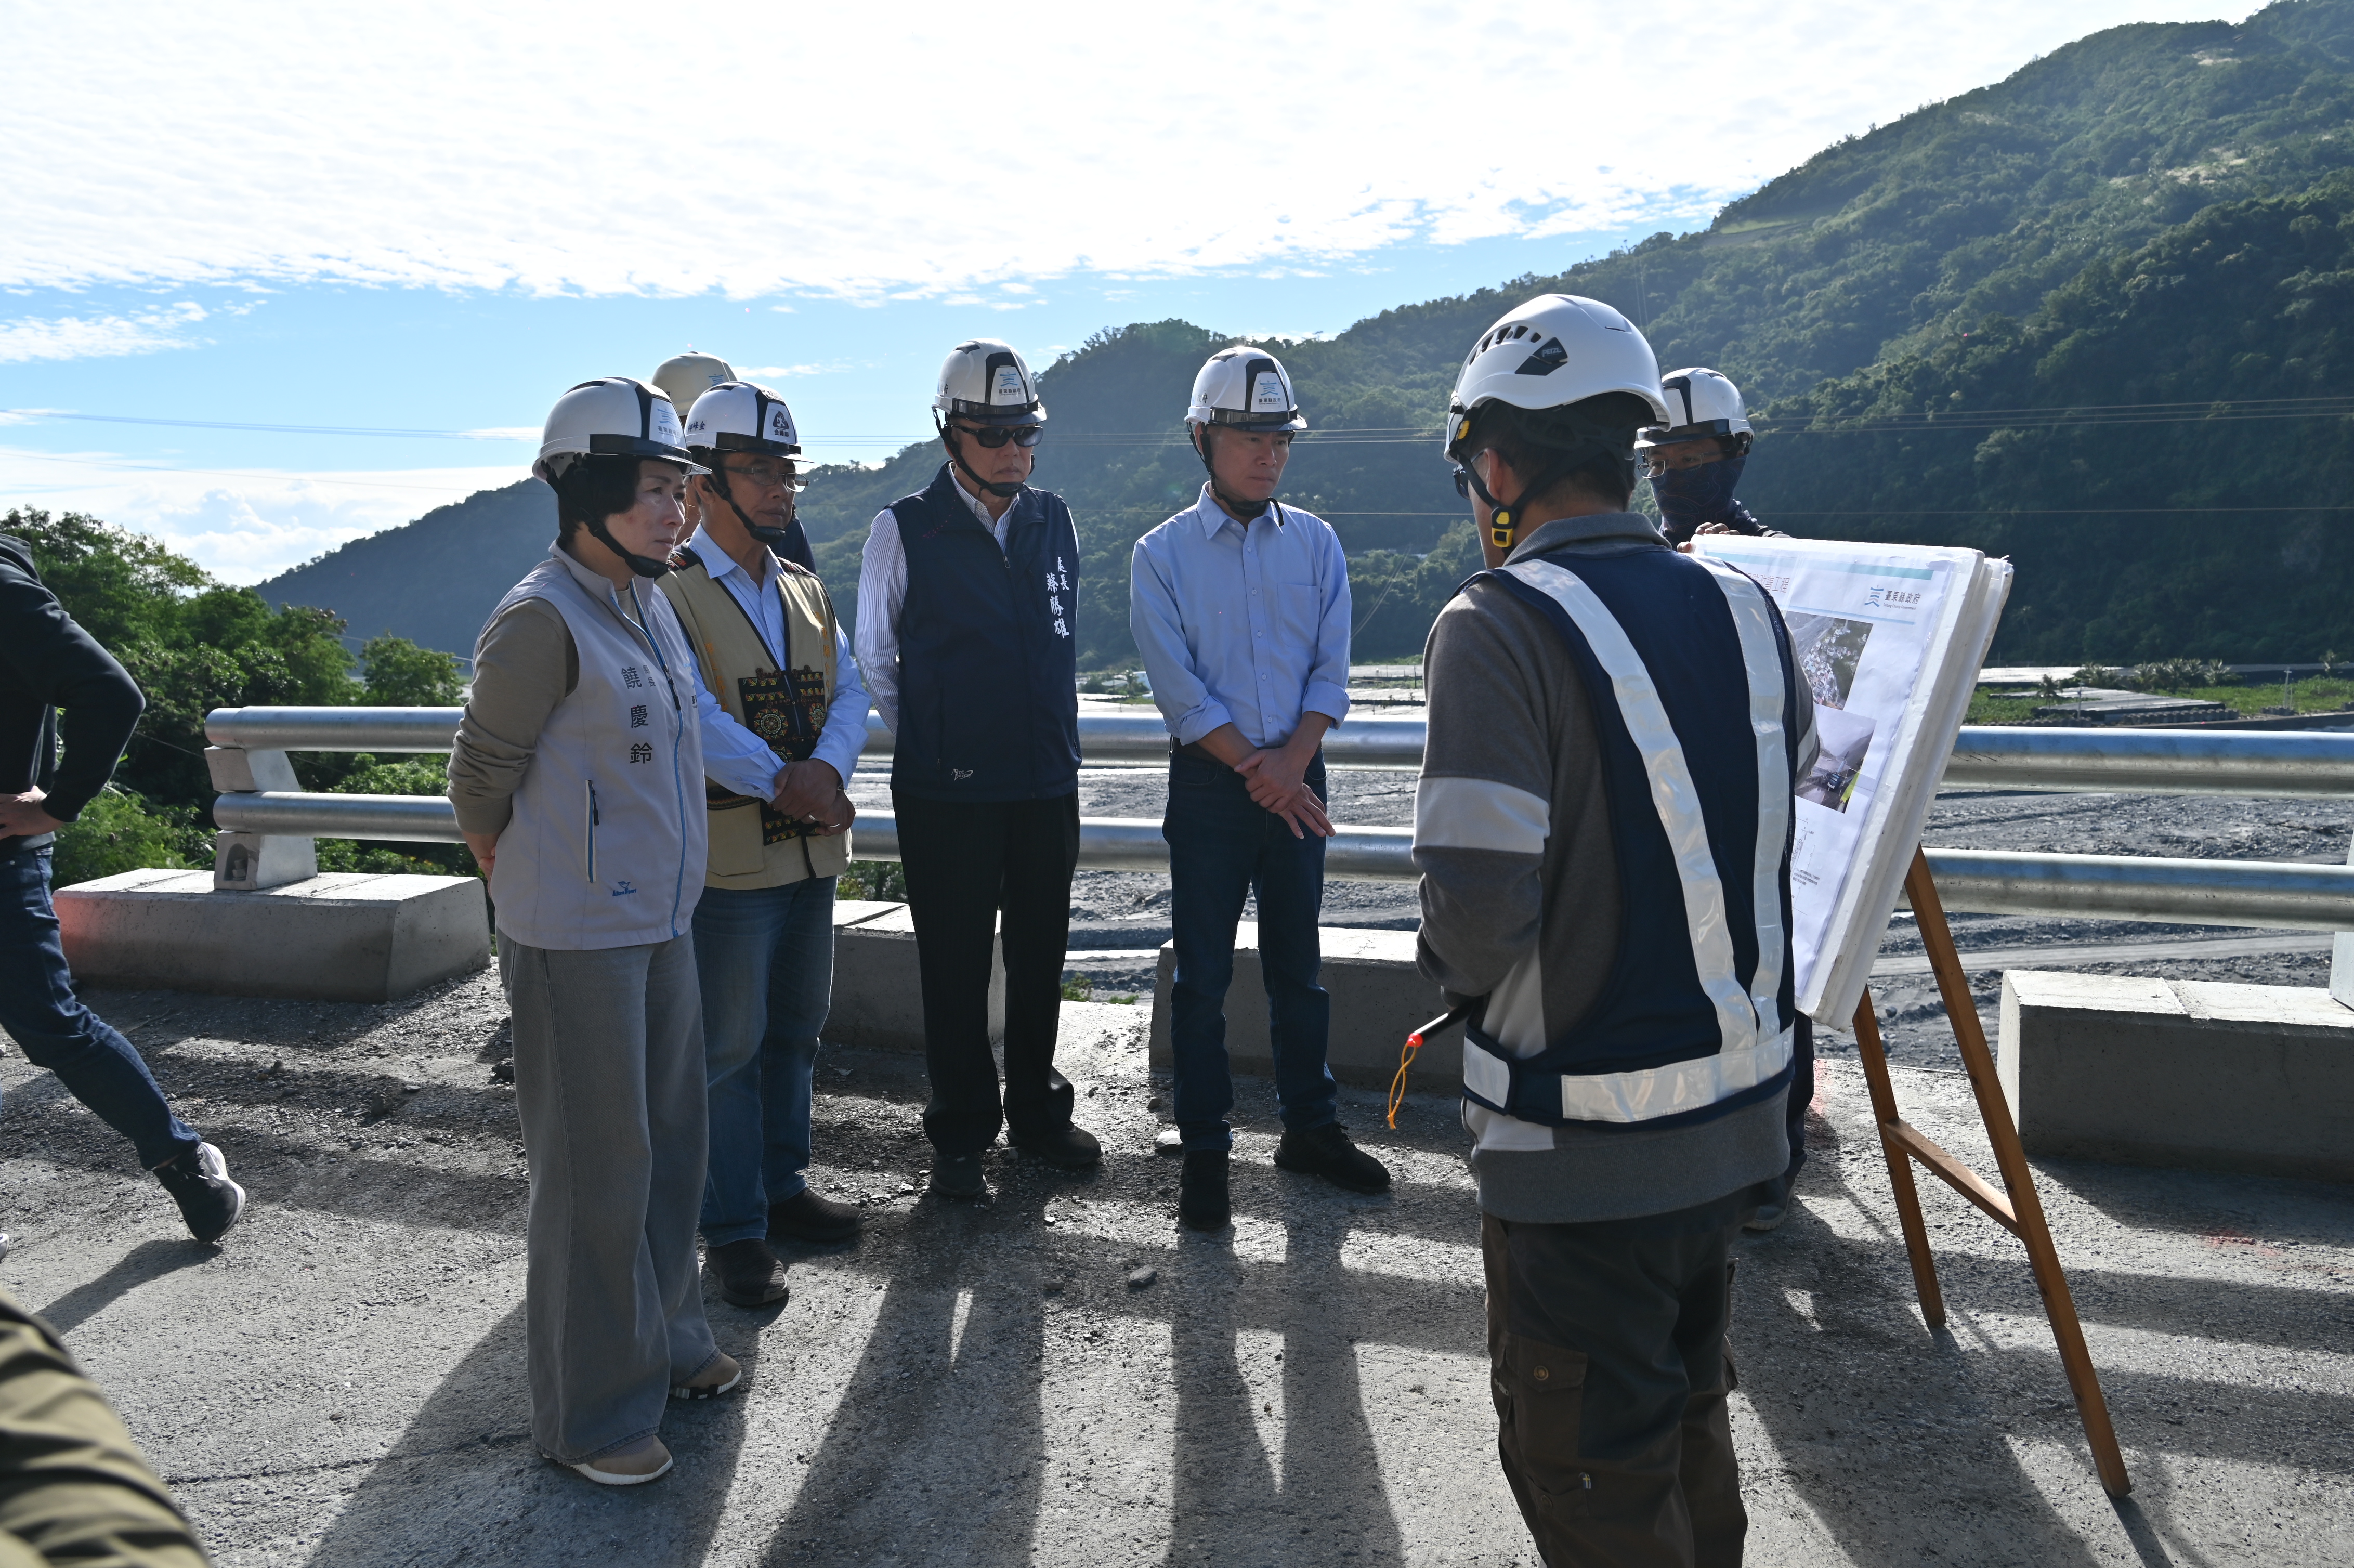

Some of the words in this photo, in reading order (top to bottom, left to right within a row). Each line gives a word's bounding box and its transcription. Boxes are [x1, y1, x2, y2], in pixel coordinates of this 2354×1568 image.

[1542, 347, 1562, 358] PETZL
[1057, 556, 1070, 591] 處長
[1046, 572, 1070, 639] 蔡勝雄
[1885, 590, 1921, 604] 臺東縣政府
[621, 666, 653, 764] 饒慶鈴
